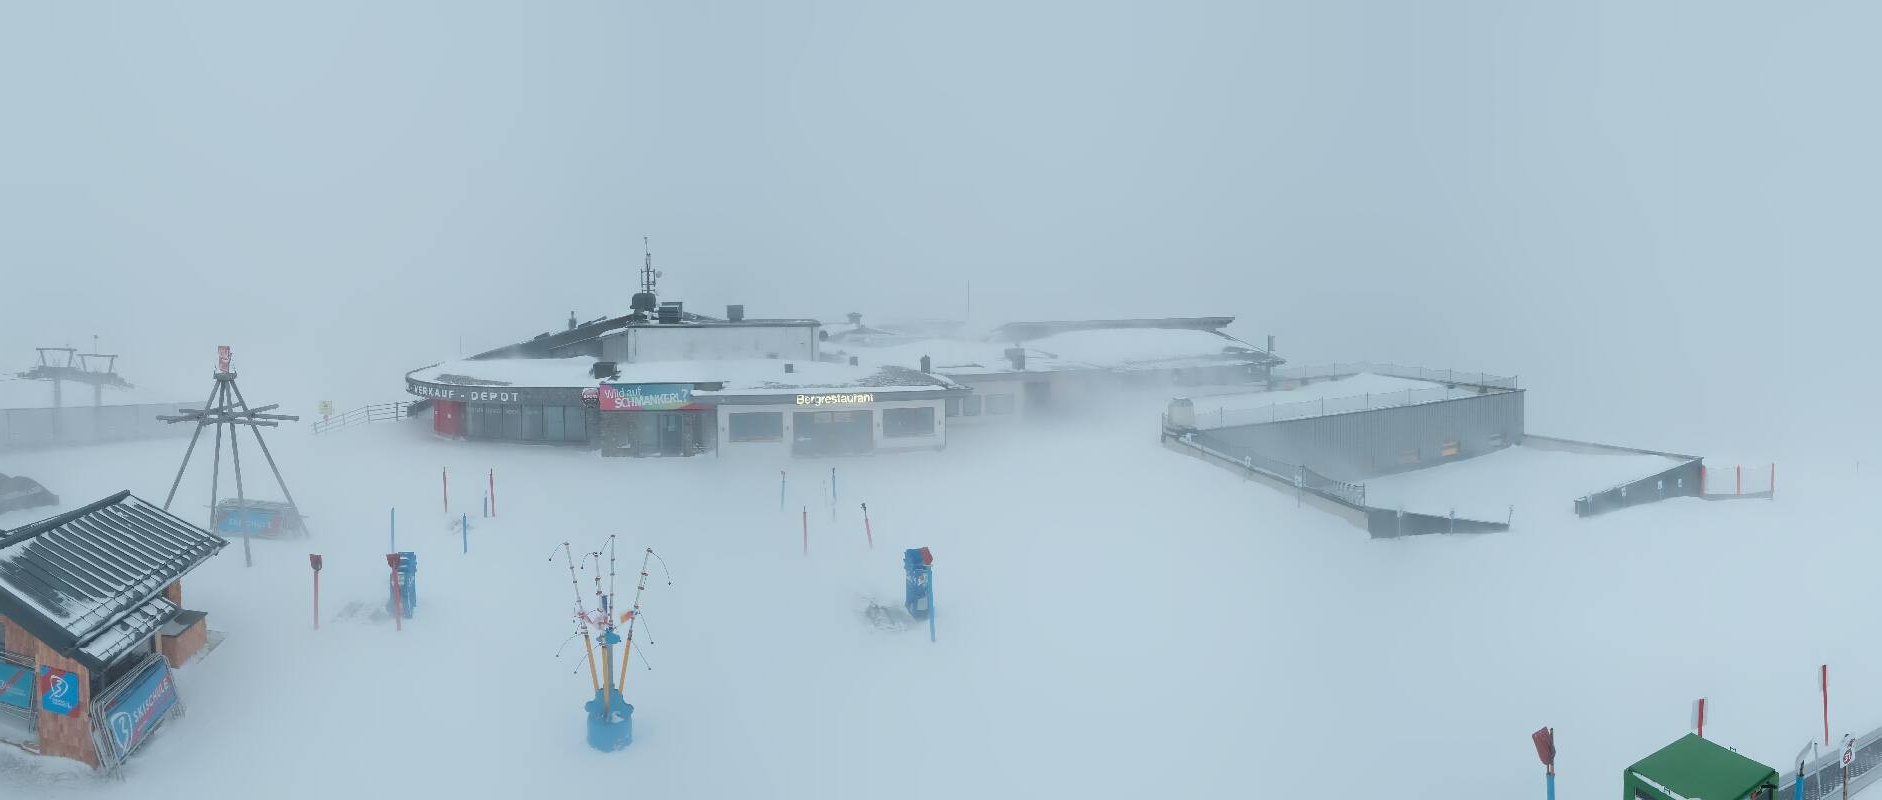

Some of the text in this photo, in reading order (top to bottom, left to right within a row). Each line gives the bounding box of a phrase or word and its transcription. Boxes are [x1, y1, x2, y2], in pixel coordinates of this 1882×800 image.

[414, 385, 455, 399] VERKAUF
[471, 391, 519, 402] DEPOT
[604, 385, 642, 399] Wild auf
[796, 393, 874, 406] Bergrestaurant
[133, 678, 169, 723] SKISCHULE
